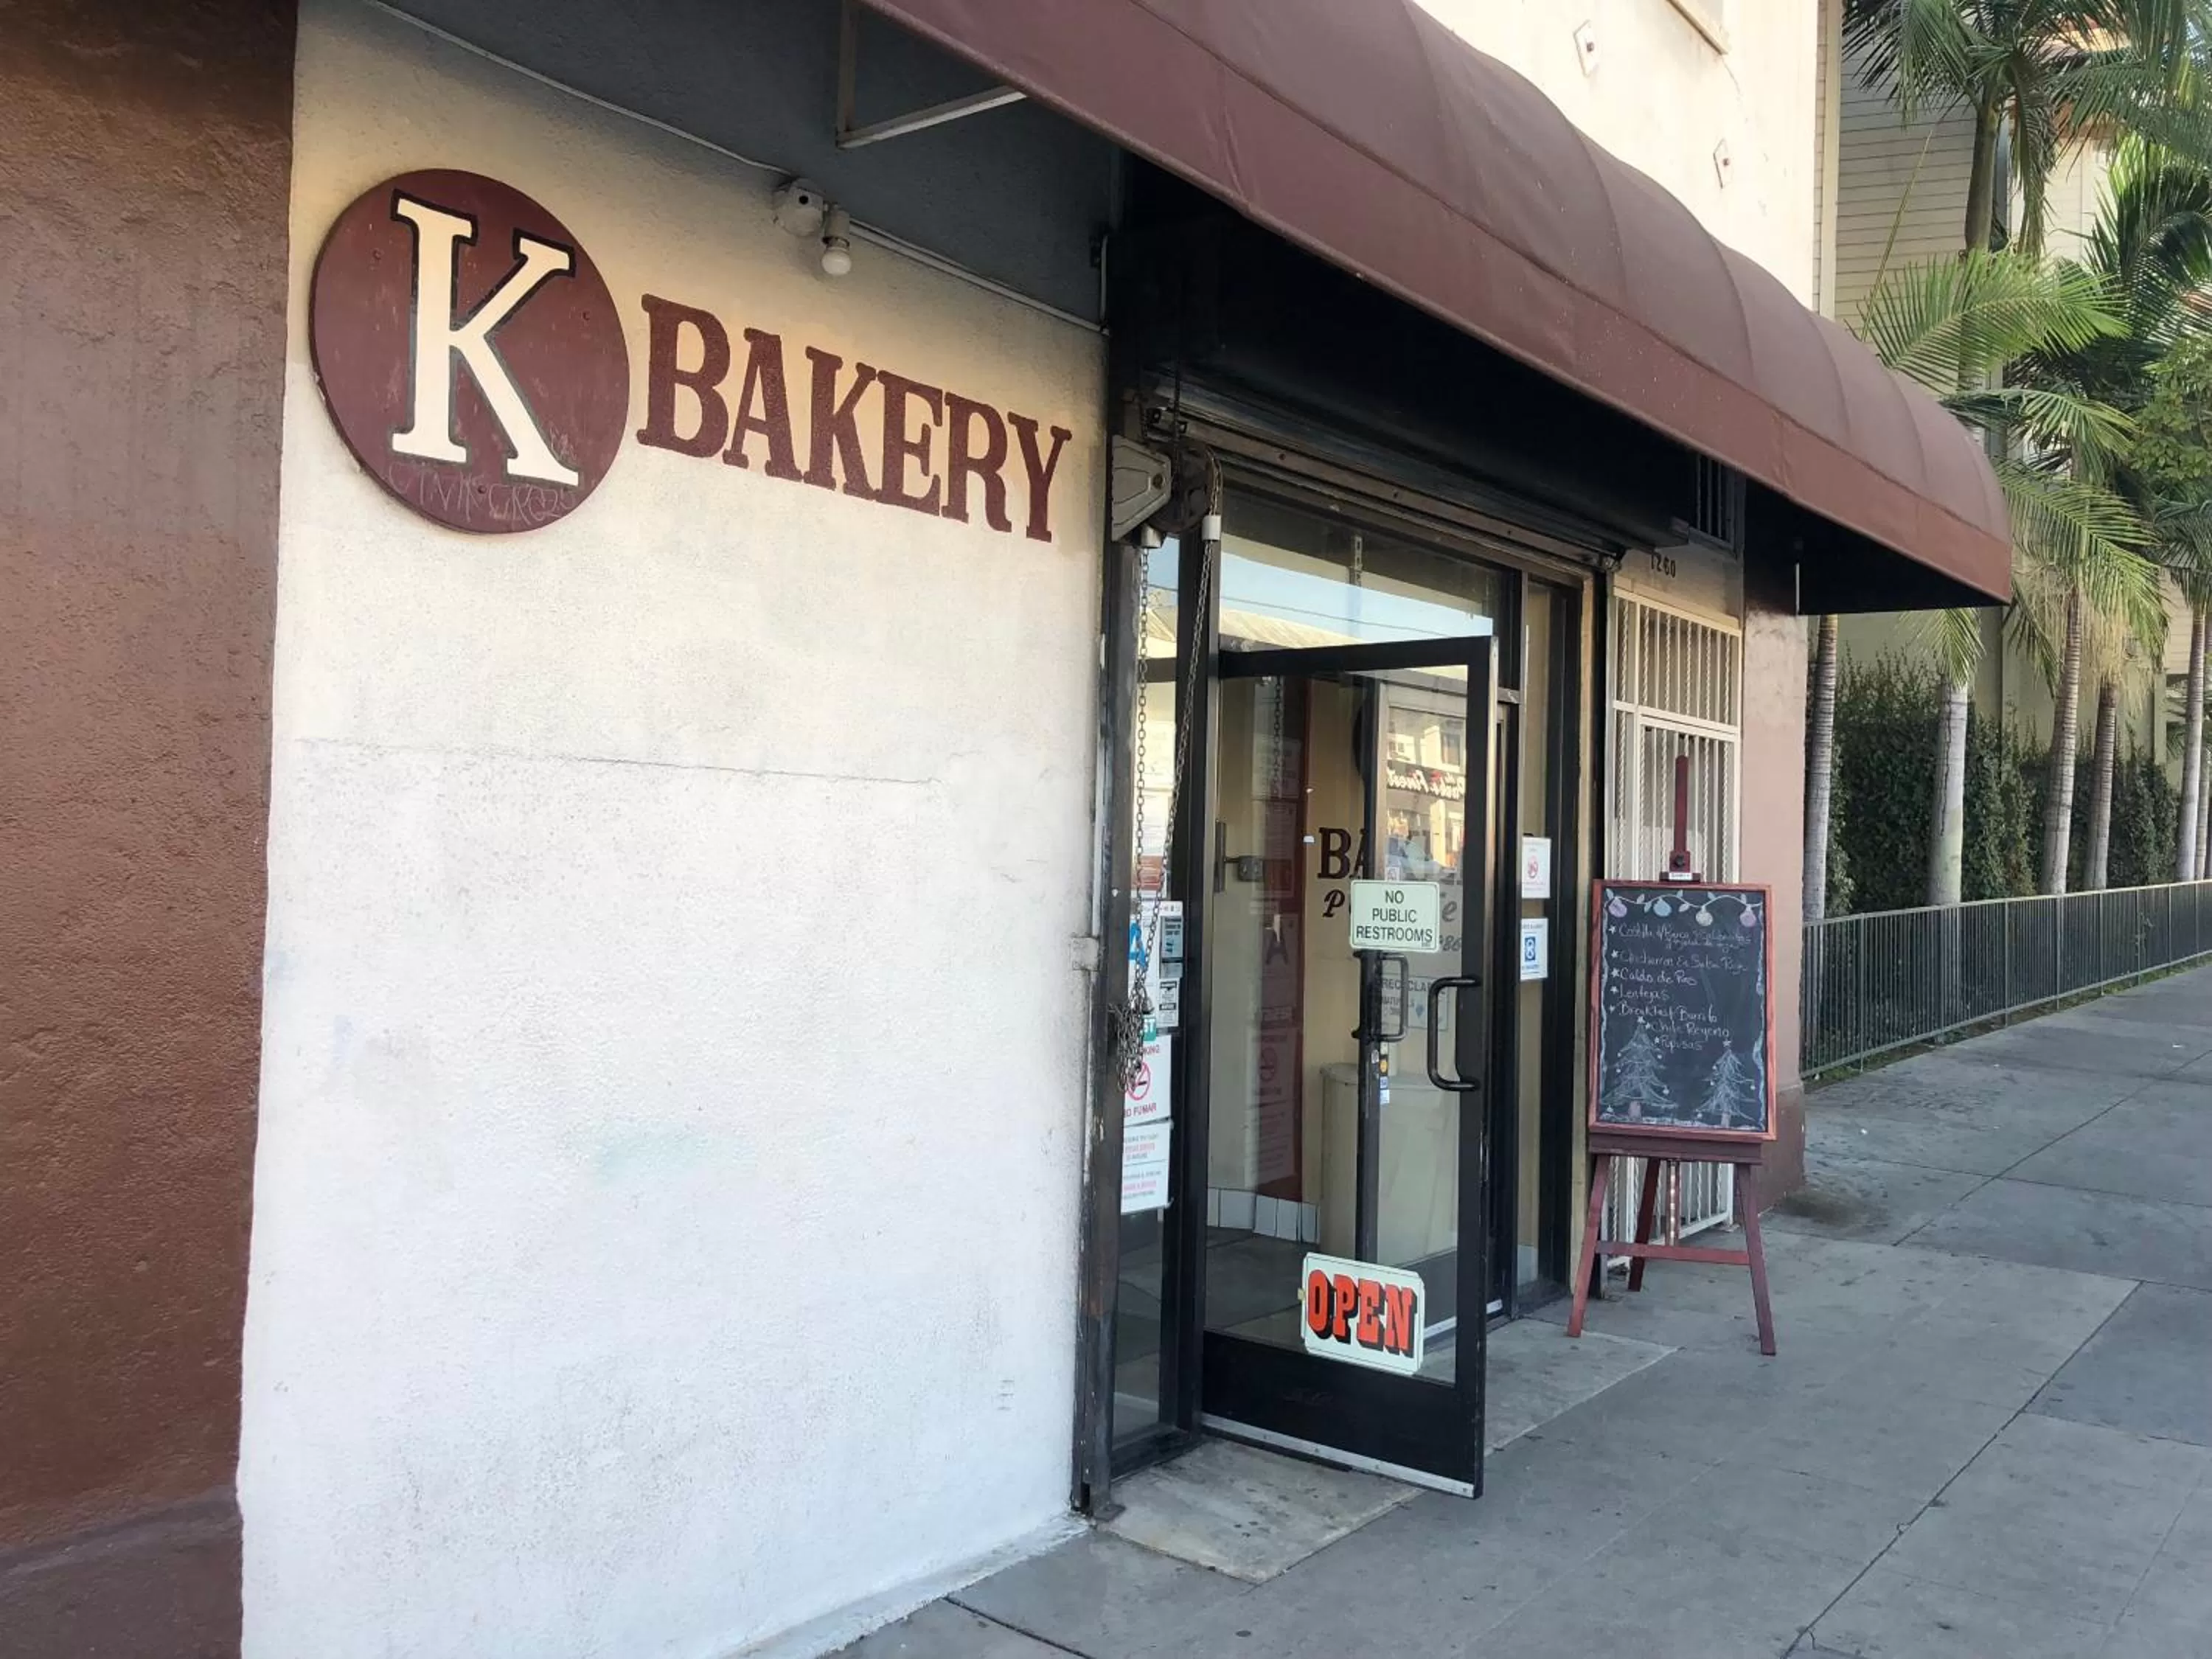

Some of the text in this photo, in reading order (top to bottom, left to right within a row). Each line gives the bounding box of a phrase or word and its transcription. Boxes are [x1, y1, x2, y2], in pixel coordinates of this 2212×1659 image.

[390, 190, 1072, 543] K BAKERY
[1385, 890, 1405, 905] NO
[1371, 908, 1417, 923] PUBLIC
[1356, 925, 1433, 943] RESTROOMS
[1307, 1268, 1418, 1359] OPEN
